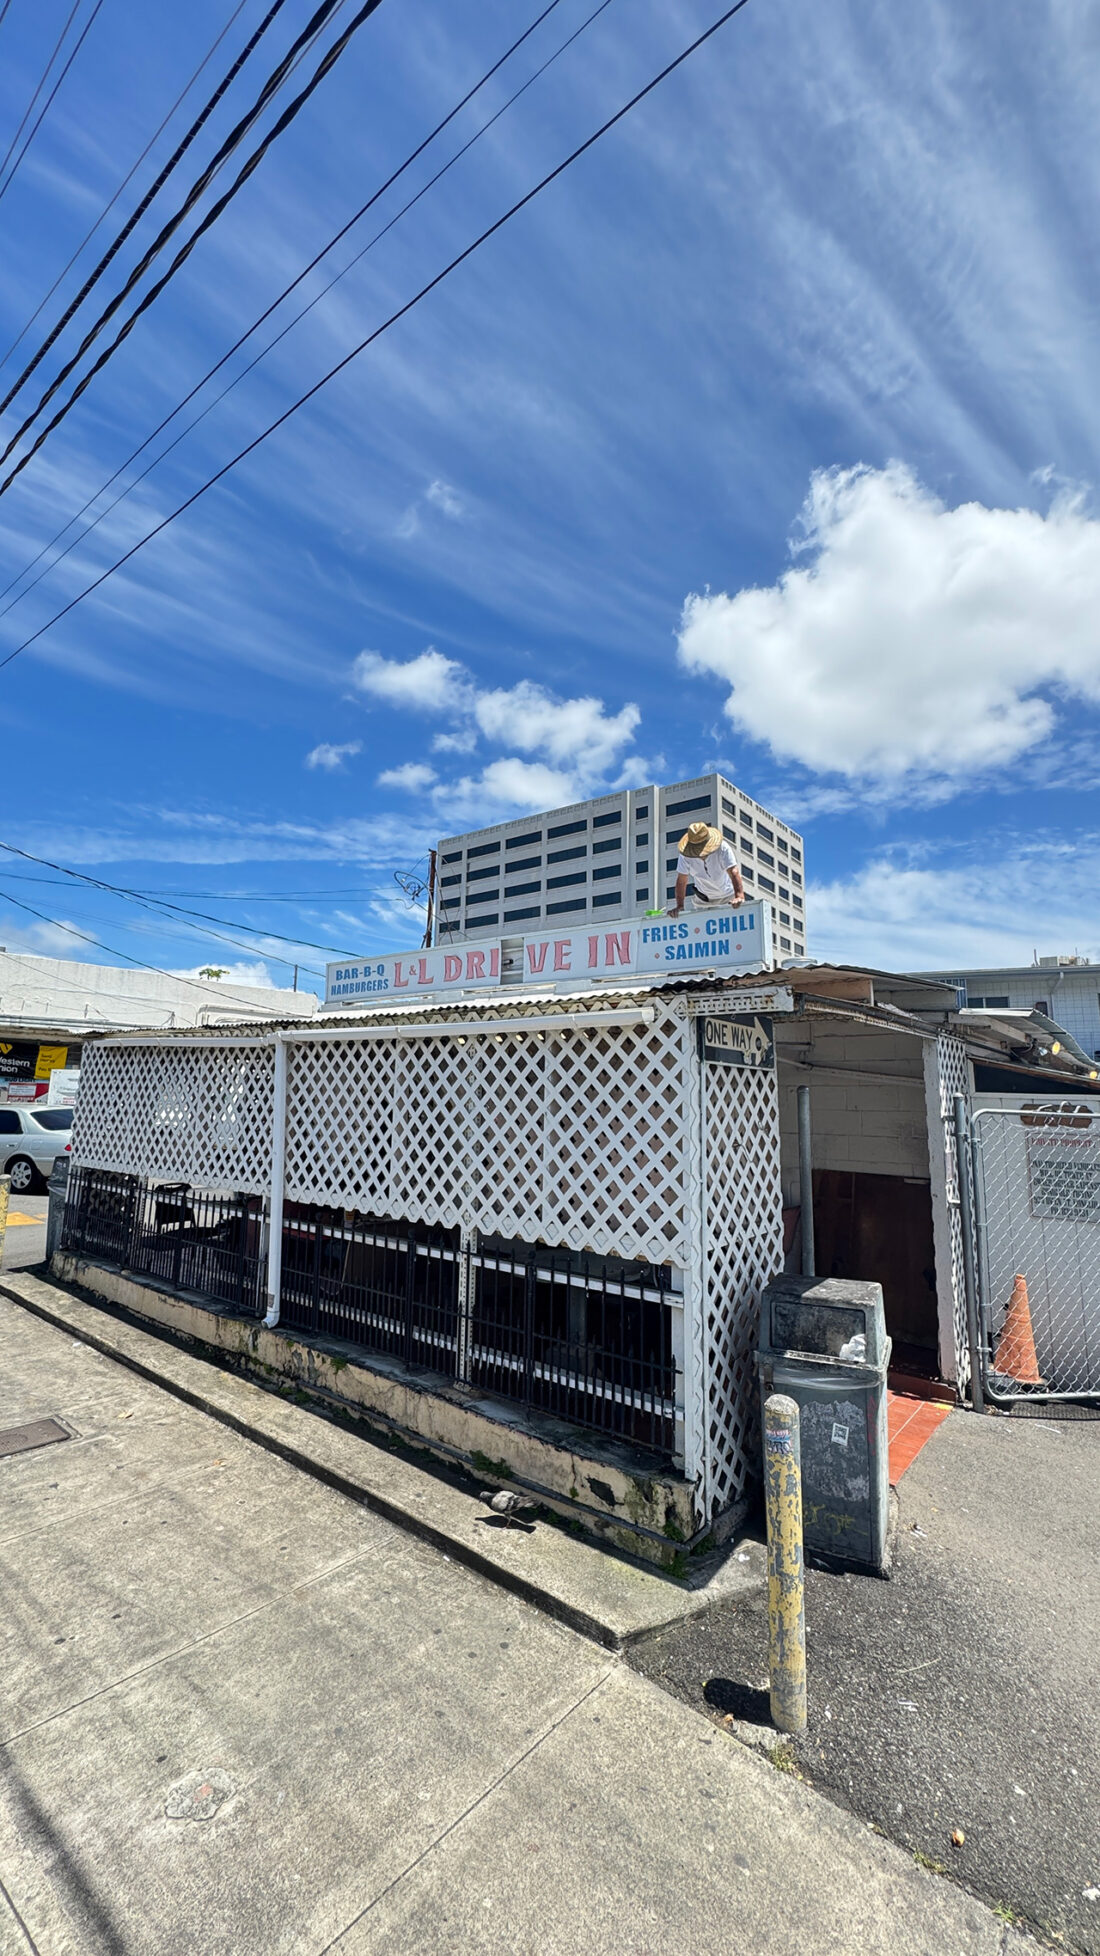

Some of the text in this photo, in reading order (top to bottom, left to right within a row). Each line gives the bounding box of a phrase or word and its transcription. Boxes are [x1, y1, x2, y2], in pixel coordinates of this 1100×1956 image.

[642, 913, 755, 944] FRIES CHILI
[587, 931, 631, 968] IN
[664, 939, 730, 961] SAIMIN
[335, 963, 385, 981] BAR-B-Q
[331, 978, 389, 996] HAMBURGERS
[706, 1020, 753, 1049] ONE WAY
[0, 1057, 31, 1067] estern
[0, 1064, 18, 1073] nion
